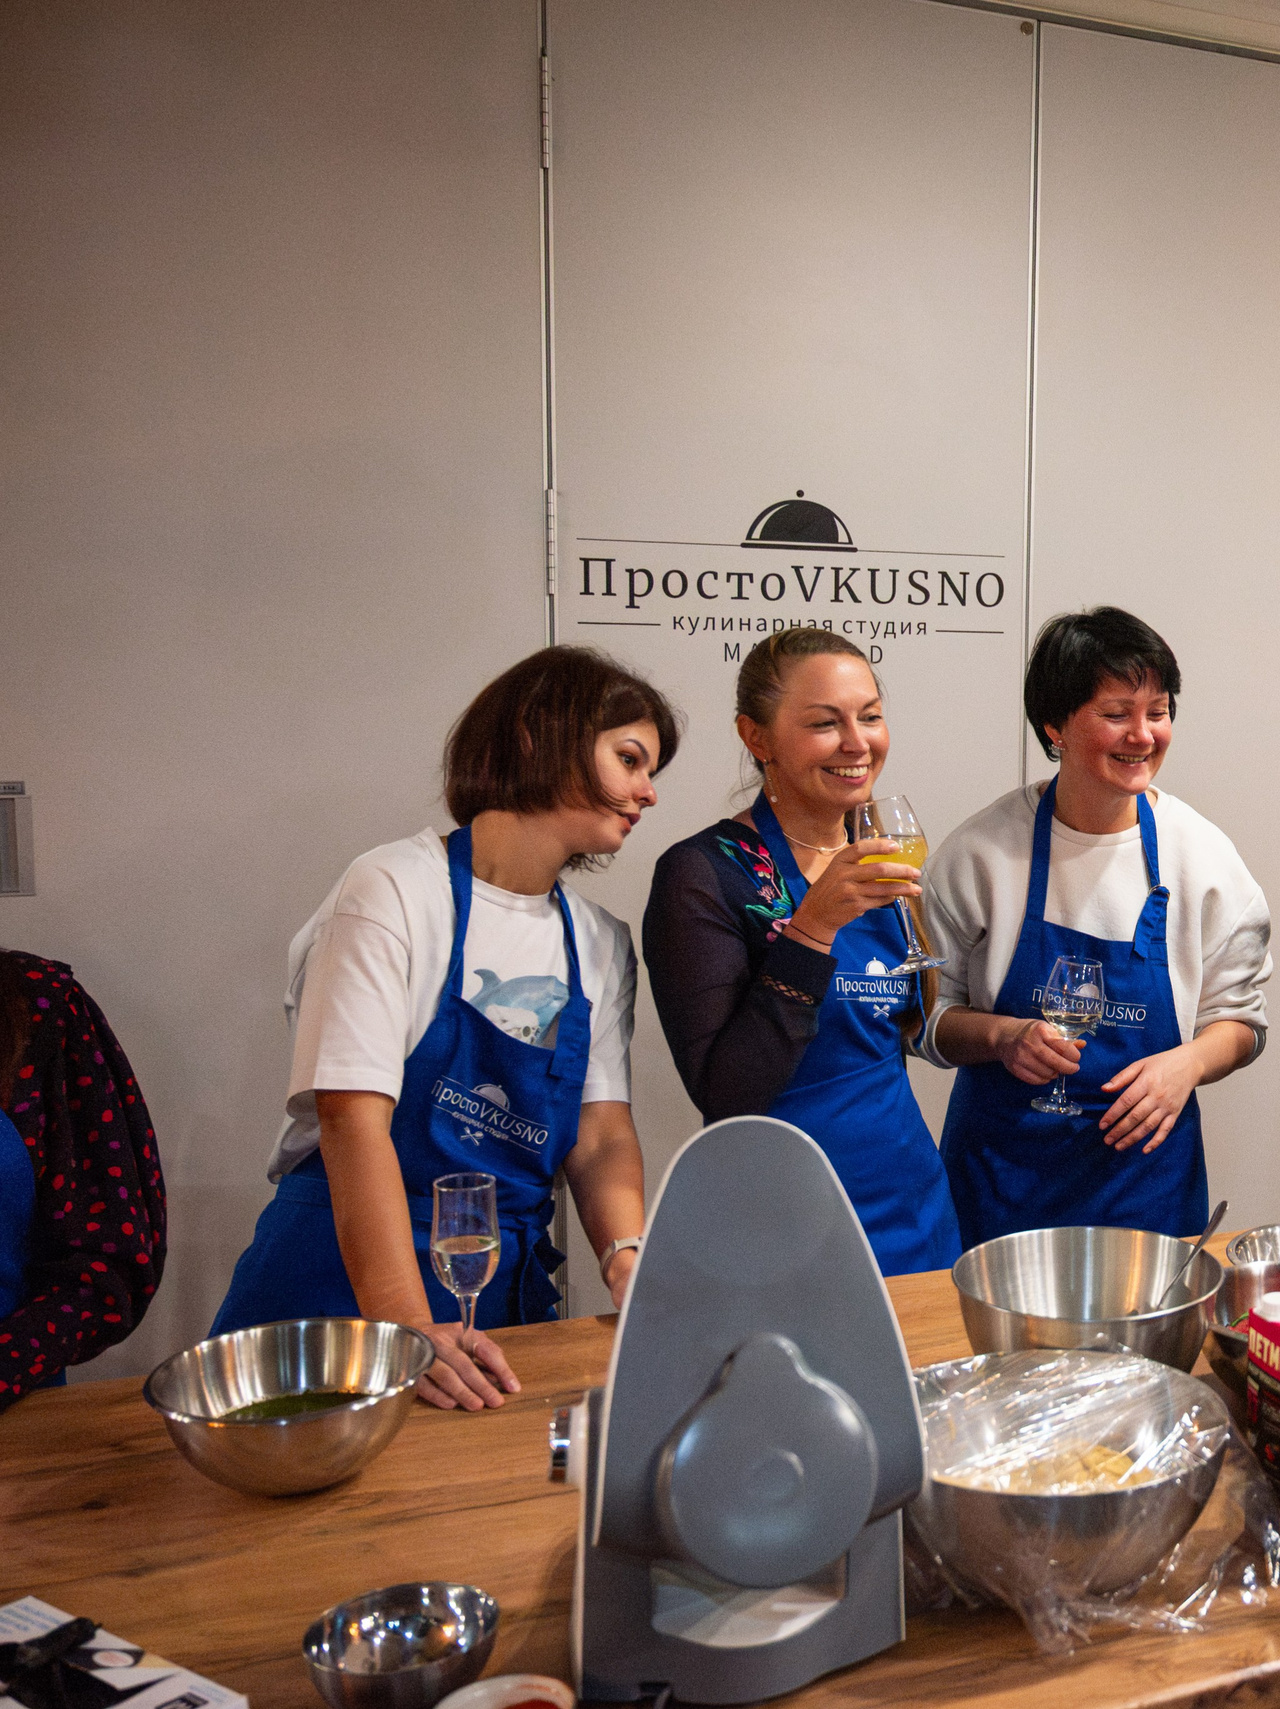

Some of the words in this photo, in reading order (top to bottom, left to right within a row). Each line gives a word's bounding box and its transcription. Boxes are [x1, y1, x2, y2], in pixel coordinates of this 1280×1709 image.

[579, 557, 1005, 609] ПростоVKUSNO
[842, 619, 928, 640] студия
[431, 1079, 549, 1145] ПростоVKUSNO
